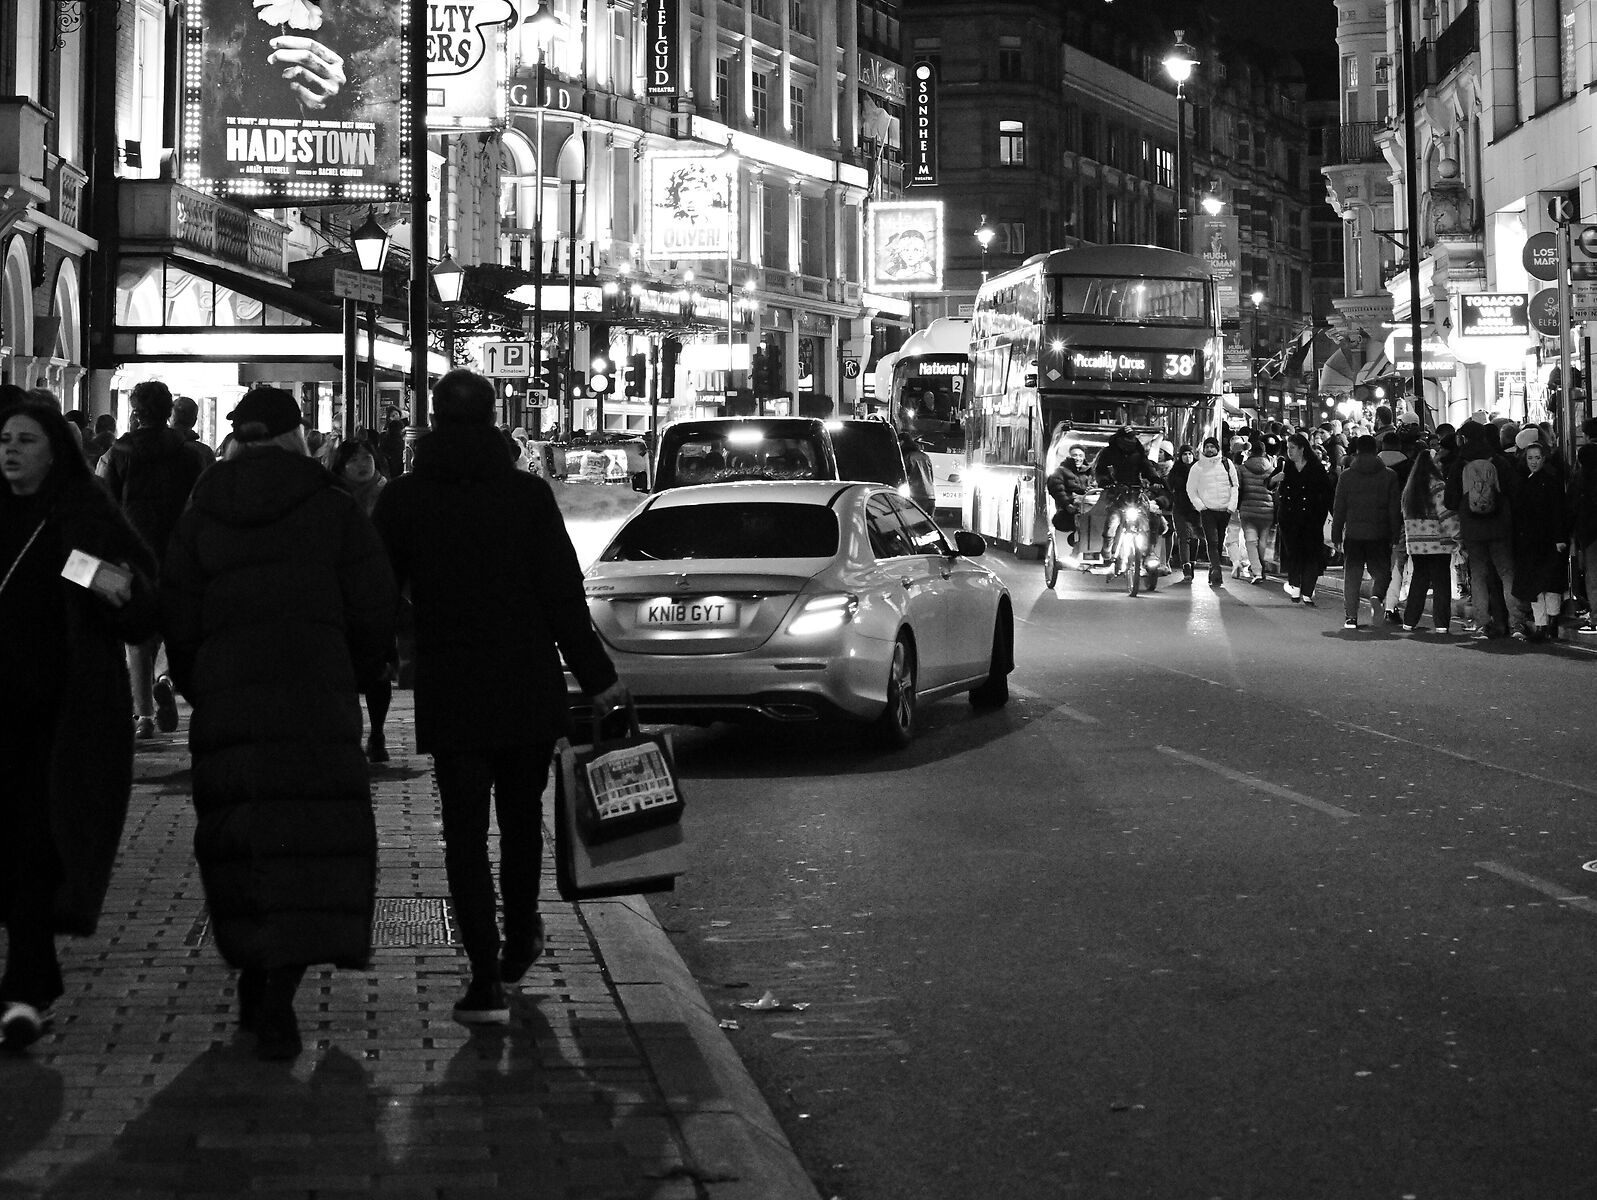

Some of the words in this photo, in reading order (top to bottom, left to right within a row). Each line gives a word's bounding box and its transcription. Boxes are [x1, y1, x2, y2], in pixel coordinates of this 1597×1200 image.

[426, 3, 475, 33] LTY
[918, 81, 930, 175] SONDHEIM
[226, 127, 375, 166] HADESTOWN
[1555, 196, 1570, 220] K
[663, 227, 721, 248] OLIVER!
[1203, 251, 1227, 261] HUGH
[1207, 259, 1236, 268] KMAN
[1465, 295, 1525, 307] TOBACCO
[507, 347, 521, 365] P
[1077, 351, 1117, 371] Piccadilly
[1119, 355, 1145, 370] Circus
[1165, 354, 1192, 376] 38
[919, 362, 960, 376] National
[954, 380, 961, 390] 2
[648, 605, 686, 622] KN18
[691, 604, 725, 621] GYT
